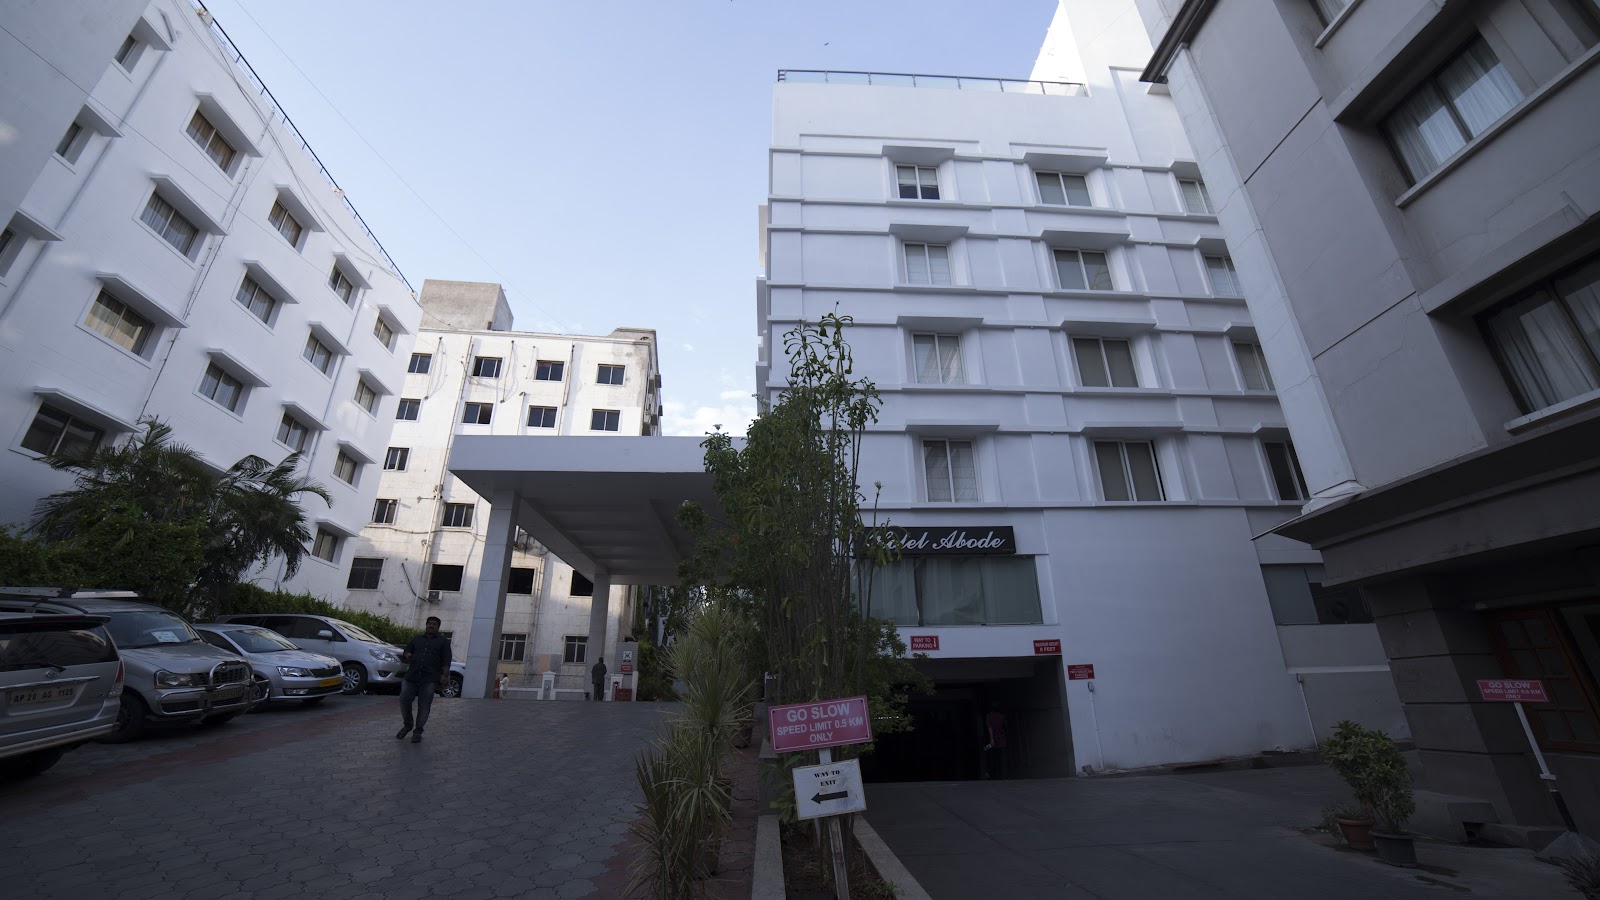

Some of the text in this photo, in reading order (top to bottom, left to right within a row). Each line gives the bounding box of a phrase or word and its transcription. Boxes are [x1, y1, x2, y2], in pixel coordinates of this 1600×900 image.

[932, 530, 1006, 550] Abode
[14, 694, 25, 703] AP
[42, 691, 52, 699] AG
[786, 703, 850, 722] GO SLOW
[777, 716, 864, 736] SPEED LIMIT 0.5 KM
[809, 732, 833, 743] ONLY
